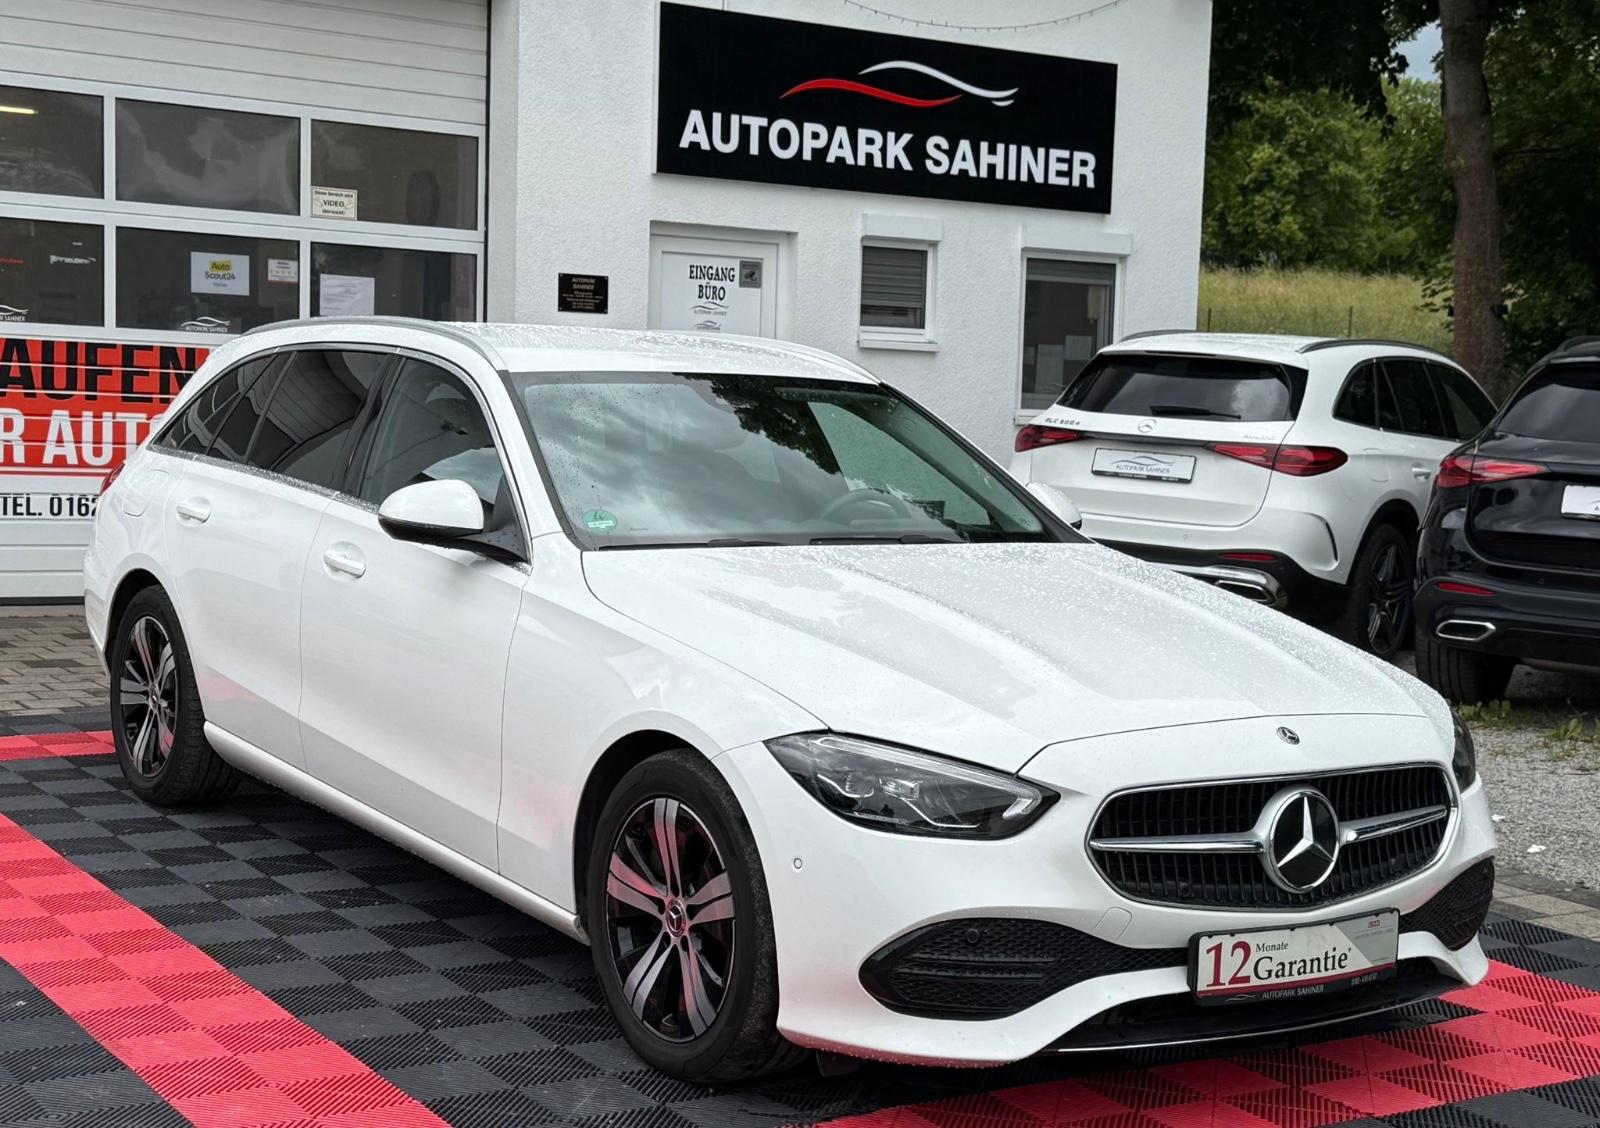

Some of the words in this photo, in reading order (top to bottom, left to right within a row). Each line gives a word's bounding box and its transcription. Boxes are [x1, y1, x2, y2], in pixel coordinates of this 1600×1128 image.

[679, 109, 913, 171] AUTOPARK
[925, 135, 1097, 188] SAHINER
[323, 199, 345, 208] VIDEO
[210, 261, 231, 271] Auto
[688, 264, 736, 283] EINGANG
[204, 271, 236, 281] Scout24
[697, 282, 726, 301] BÜRO
[0, 493, 42, 516] TEL.
[1206, 941, 1252, 988] 12
[1255, 941, 1289, 953] Monate
[1262, 989, 1296, 1000] AUTOPARK
[1297, 985, 1324, 997] SAHINER
